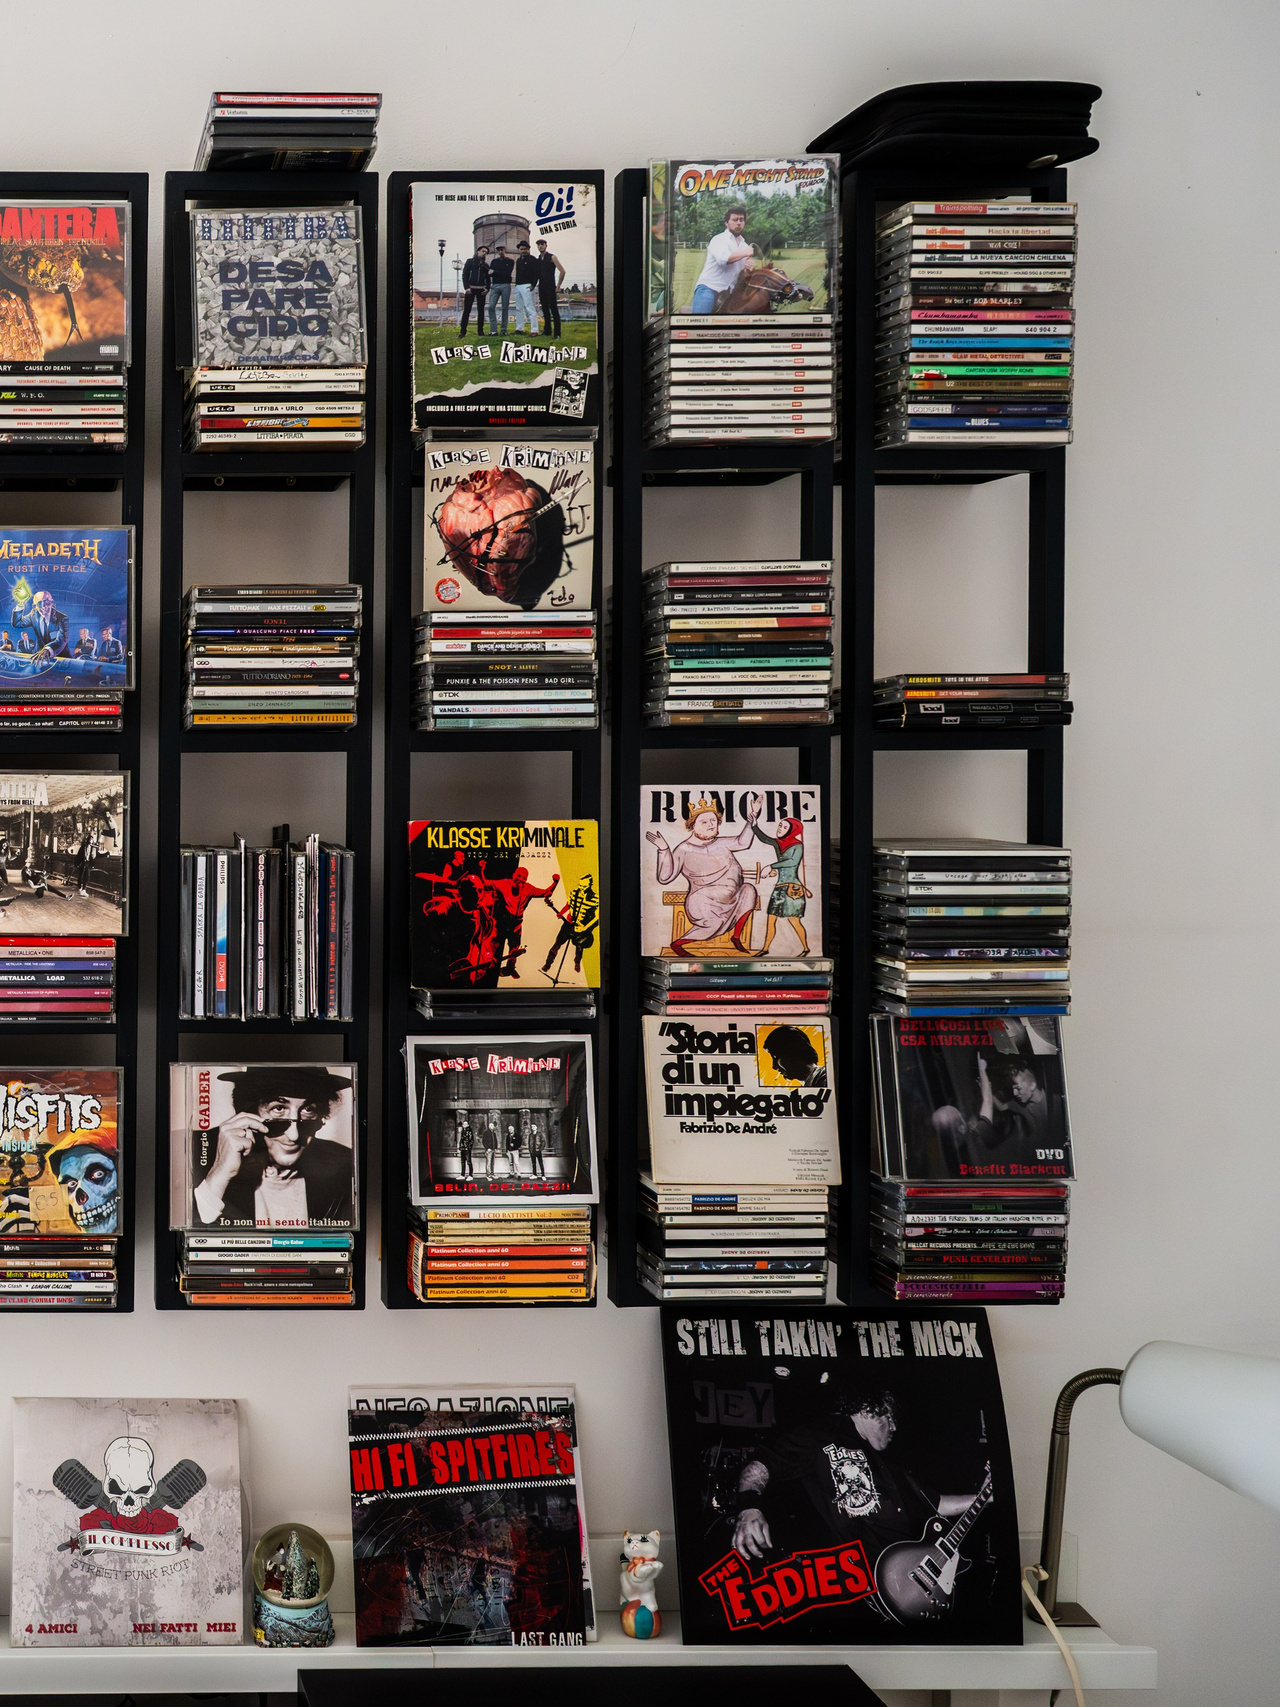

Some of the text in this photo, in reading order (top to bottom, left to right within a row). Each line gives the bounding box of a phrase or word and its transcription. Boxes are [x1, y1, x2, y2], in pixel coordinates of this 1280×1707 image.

[680, 169, 734, 197] ONE
[735, 167, 784, 187] NIGHT
[536, 186, 575, 217] Oi!
[540, 219, 577, 236] UNA STORIA
[219, 261, 334, 283] DESA
[222, 288, 332, 310] PARE
[227, 314, 329, 337] CIDO
[427, 827, 584, 849] KLASSE KRIMINALE
[661, 1056, 741, 1085] di un
[198, 1071, 210, 1130] GABER
[680, 1122, 777, 1134] Fabrizio De André
[2, 1140, 37, 1152] INSIDE!
[200, 1133, 209, 1166] Giorgio
[1036, 1149, 1064, 1160] DVD
[220, 1218, 230, 1226] Io
[256, 1218, 271, 1226] mi
[309, 1218, 350, 1226] italiano
[942, 1255, 1027, 1263] PUNK GENERATION
[677, 1319, 983, 1358] STILL TAKIN' THE MICK
[351, 1431, 575, 1492] HI FI SPITFIRES
[88, 1535, 174, 1551] IL COMPLESSO
[71, 1558, 190, 1581] STREET PUNK RIOT
[706, 1560, 740, 1587] THE
[723, 1549, 870, 1620] EDDiES
[25, 1622, 236, 1634] 4 AMICI NEI FATTI MIEI
[512, 1632, 583, 1646] LAST GANG
